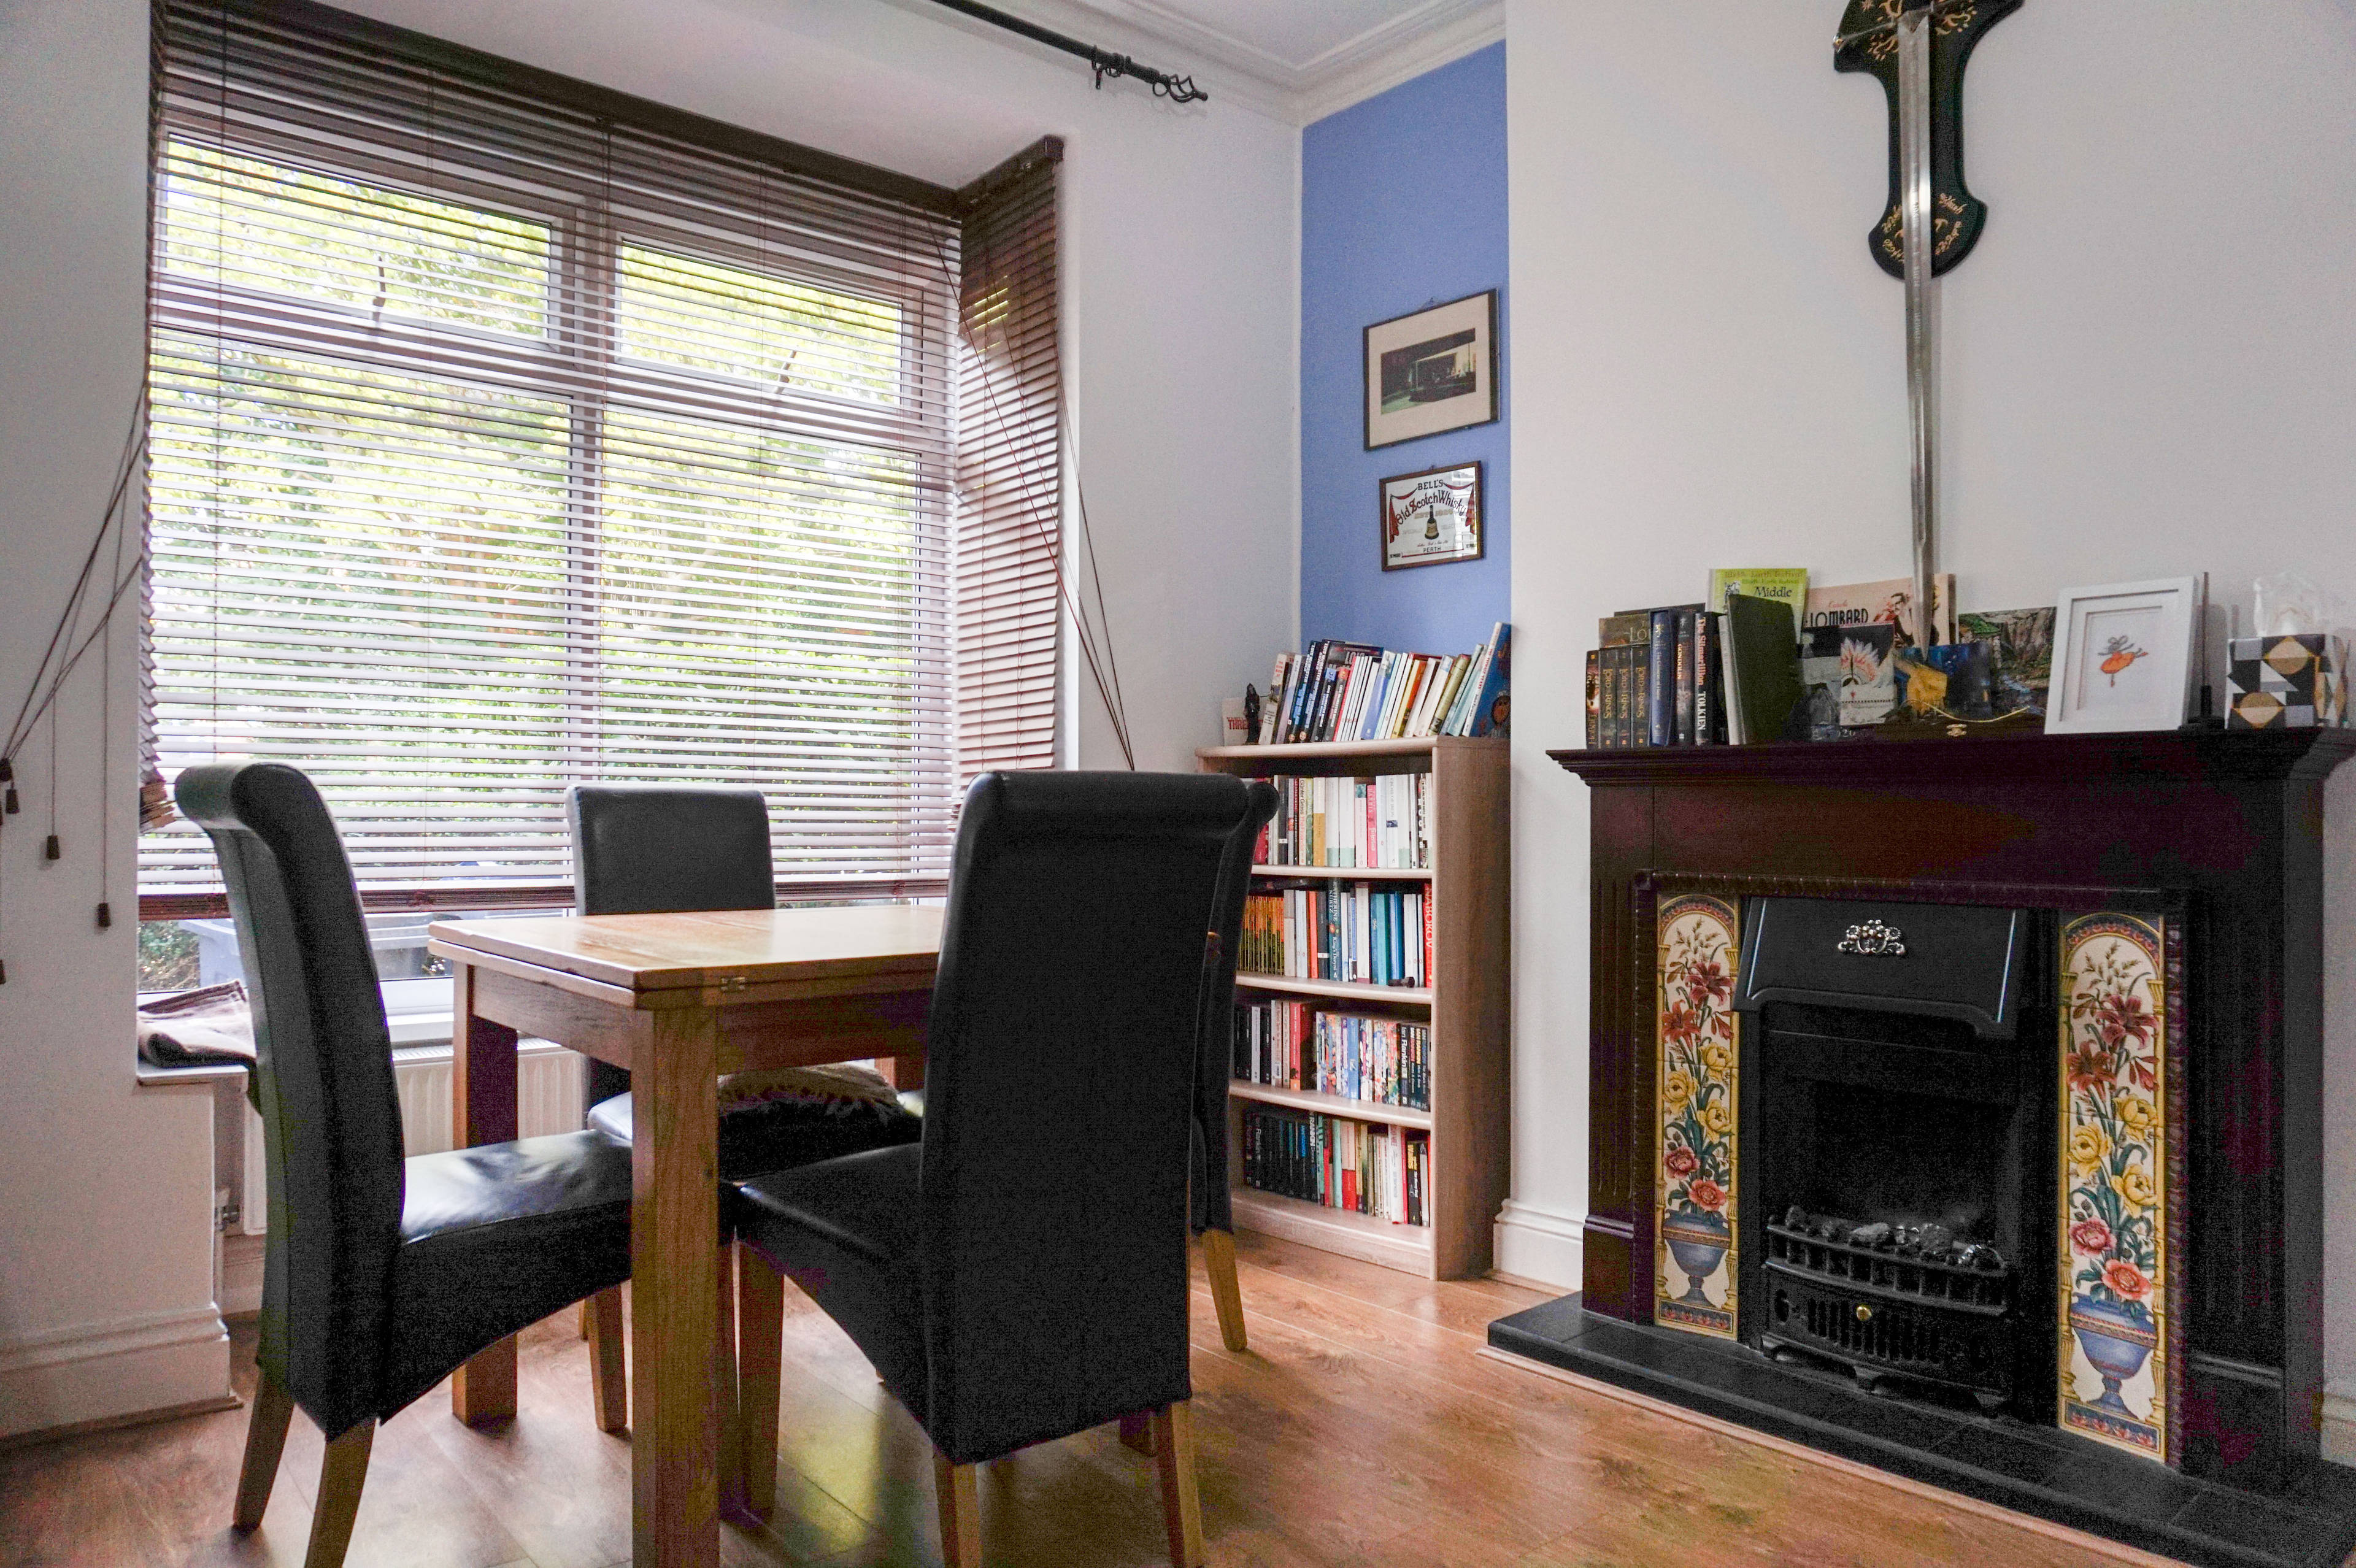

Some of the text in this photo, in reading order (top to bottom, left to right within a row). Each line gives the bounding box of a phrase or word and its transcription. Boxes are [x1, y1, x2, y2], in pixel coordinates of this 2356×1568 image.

[1417, 480, 1443, 491] BELL'S
[1396, 490, 1466, 525] Old Scotch Whisky
[1755, 586, 1792, 597] Middle
[1698, 618, 1706, 731] The Silmarillion TOLKIEN
